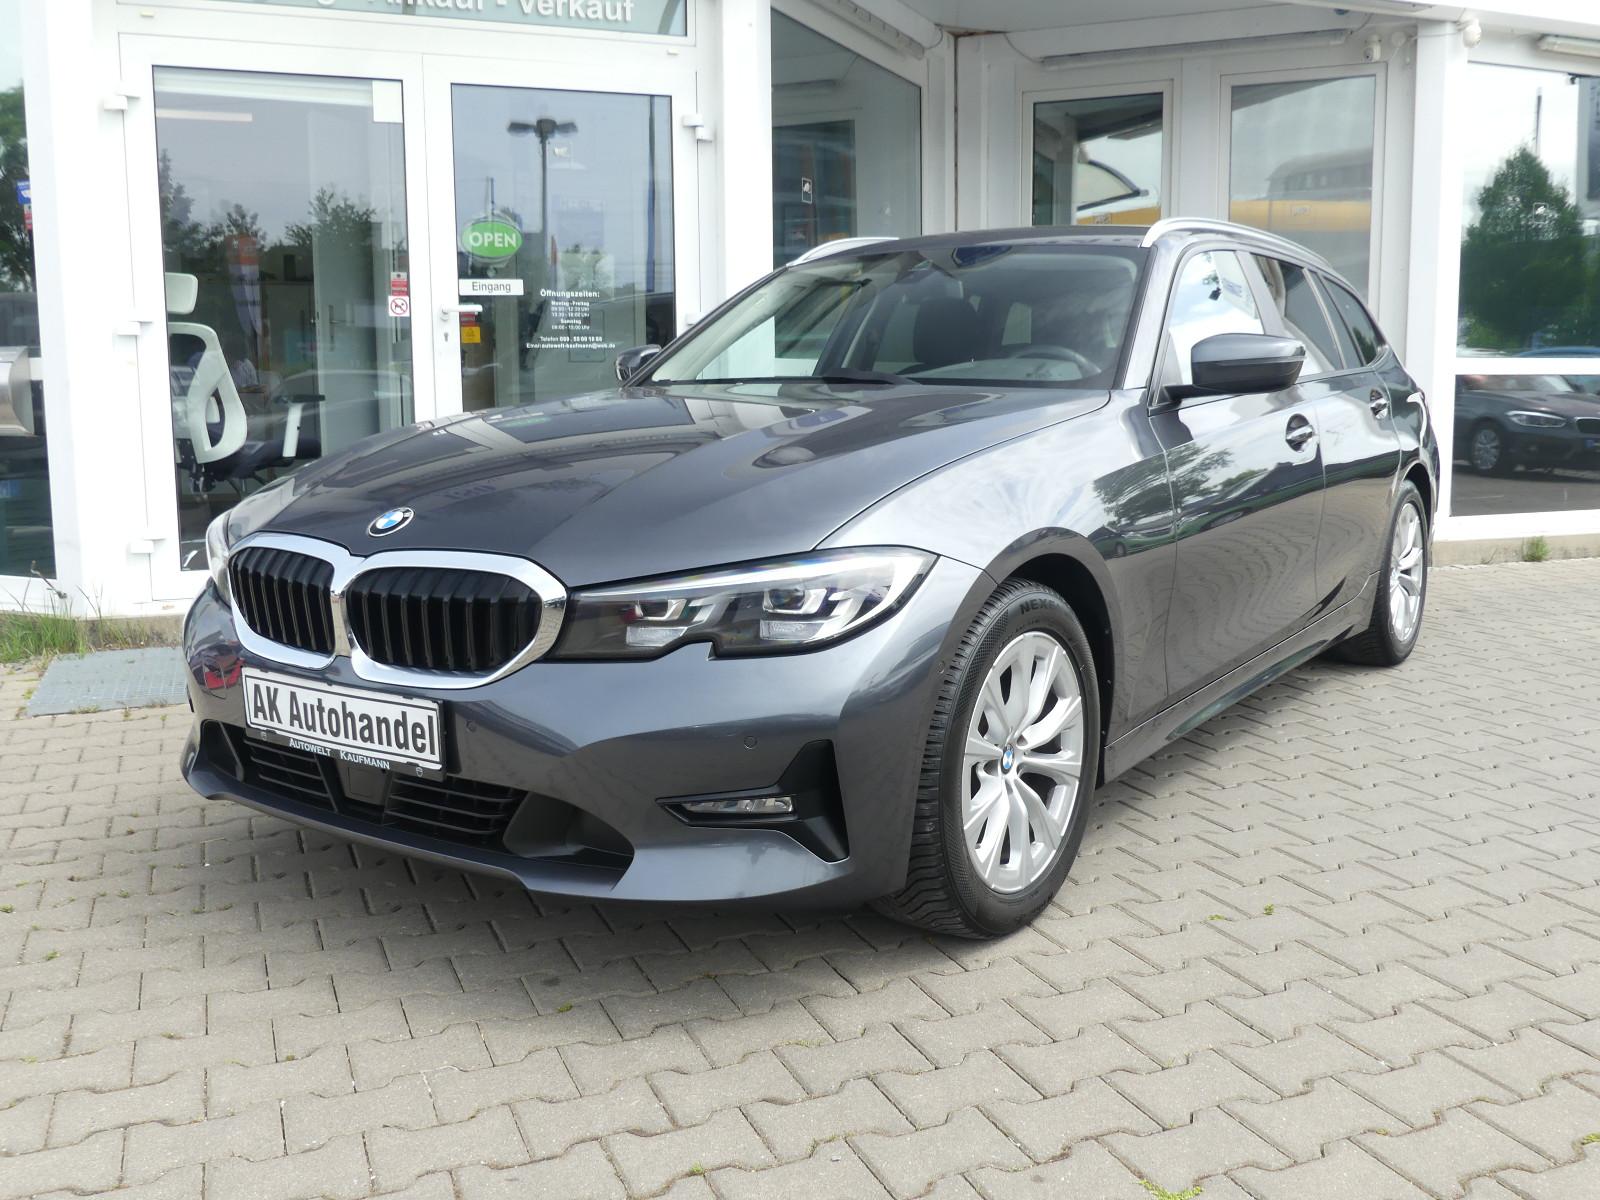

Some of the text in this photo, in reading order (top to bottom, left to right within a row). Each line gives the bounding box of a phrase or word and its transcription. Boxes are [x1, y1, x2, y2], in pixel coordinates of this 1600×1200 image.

[469, 232, 517, 248] OPEN
[471, 281, 512, 294] Eingang
[540, 288, 600, 299] Öffnungszeiten:
[1020, 598, 1061, 615] NEXE
[253, 683, 437, 756] AK Autohandel
[288, 738, 391, 770] AUTOWELT KAUFMANN
